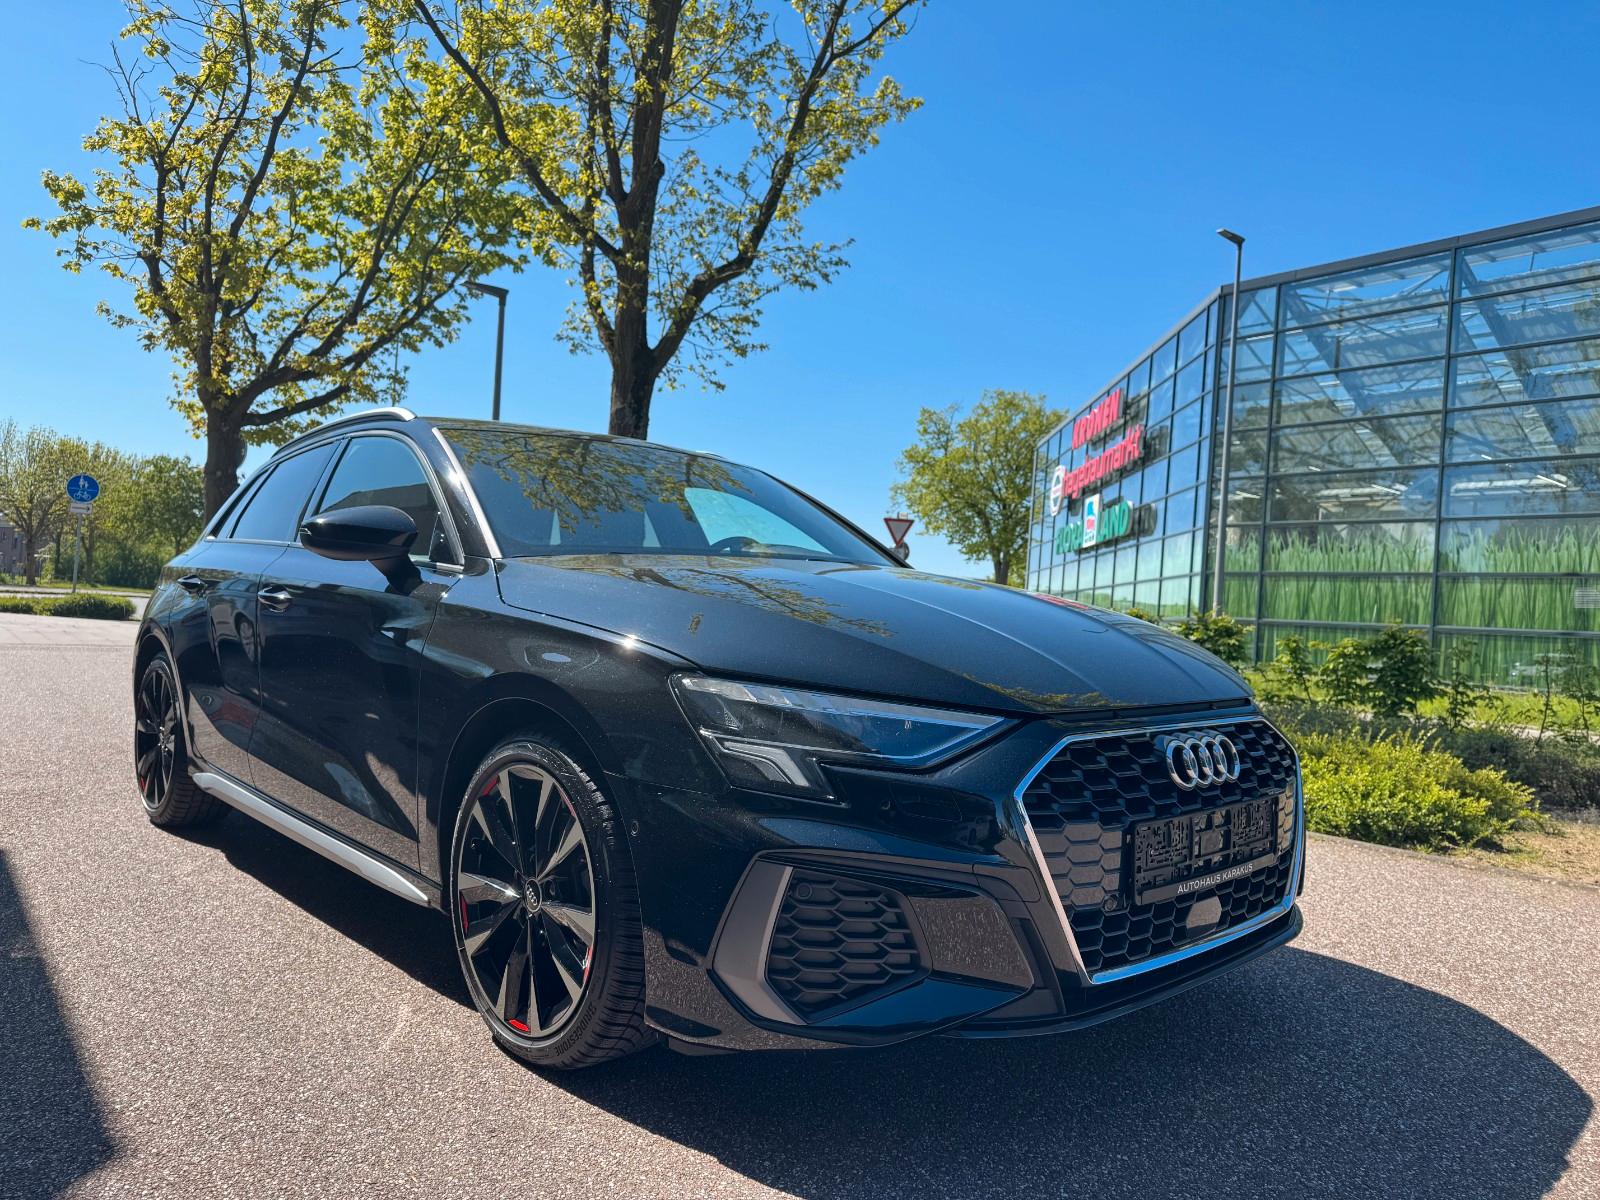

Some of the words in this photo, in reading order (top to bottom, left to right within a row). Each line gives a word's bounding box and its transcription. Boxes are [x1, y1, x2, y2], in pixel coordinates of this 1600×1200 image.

[1177, 874, 1221, 893] AUTOHAUS
[1222, 863, 1253, 881] KARAKUS
[554, 1001, 597, 1057] BRIDGESTONE
